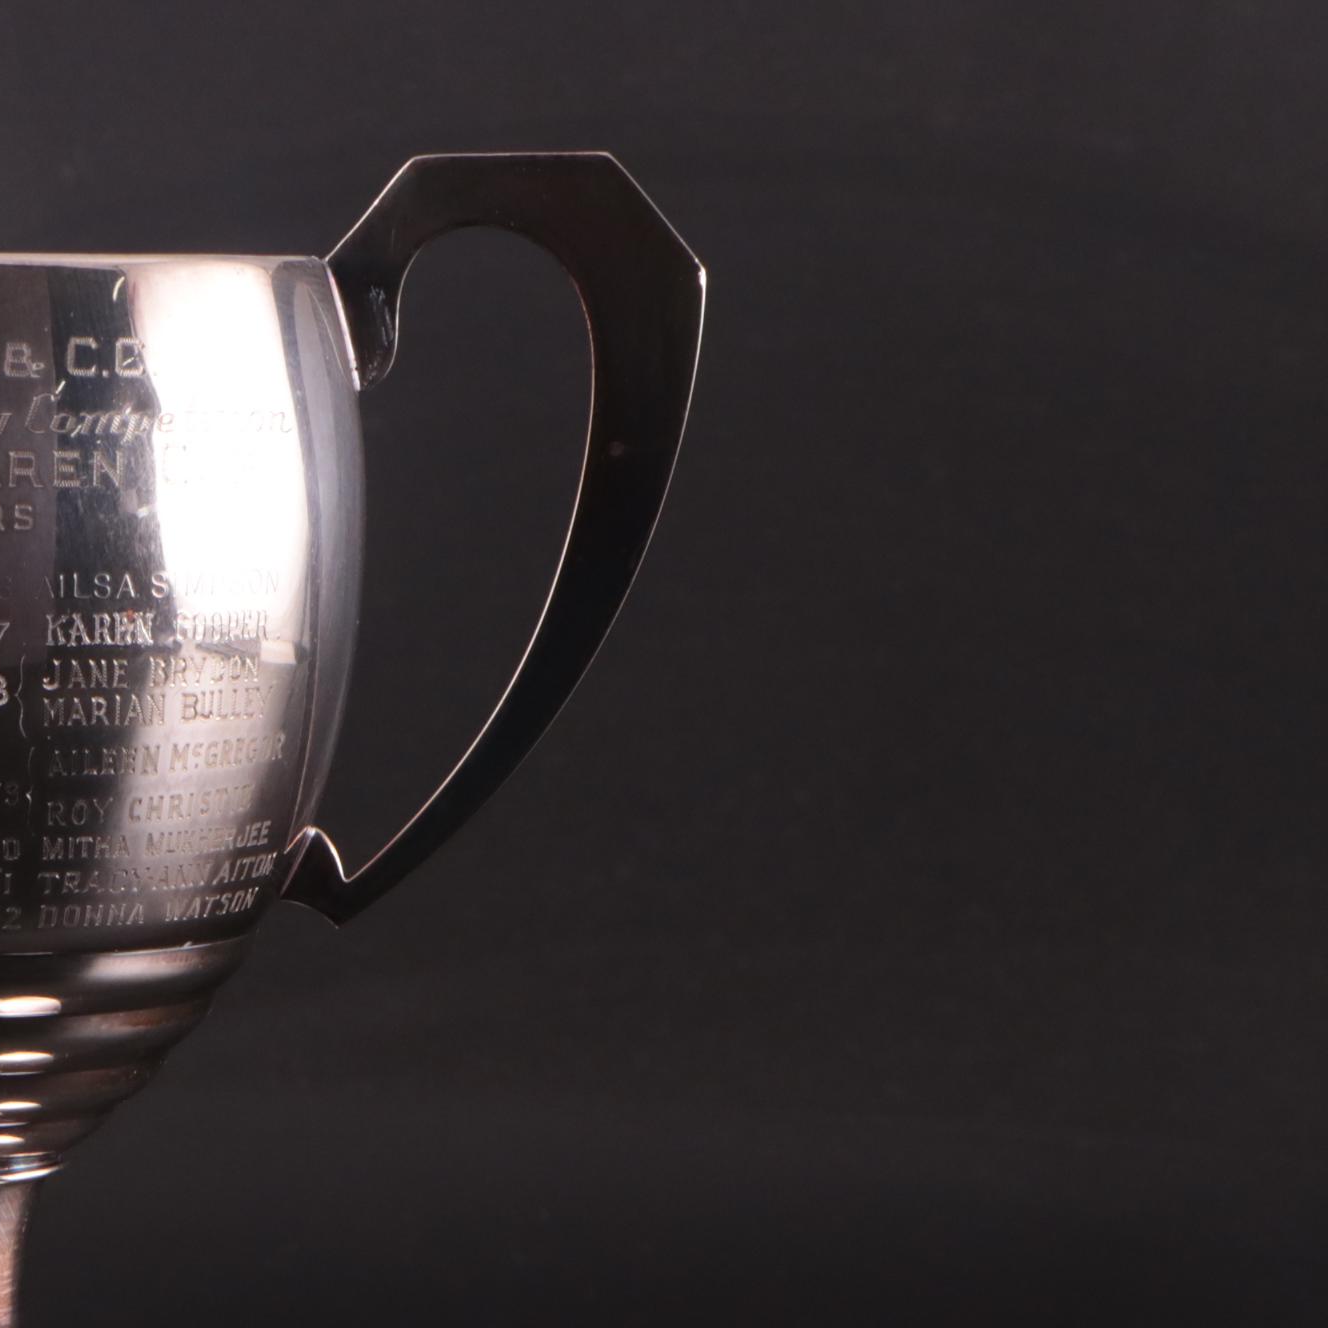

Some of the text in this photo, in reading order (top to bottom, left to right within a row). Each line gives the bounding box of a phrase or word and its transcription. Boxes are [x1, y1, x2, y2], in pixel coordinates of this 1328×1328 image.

[33, 572, 138, 600] AILSA
[151, 569, 279, 599] SIMPON
[45, 612, 154, 647] KAREN
[42, 658, 129, 690] JANE
[43, 693, 166, 727] MARIAN
[46, 796, 114, 827] ROY
[37, 902, 144, 931] DONNA
[165, 886, 260, 922] WATSON
